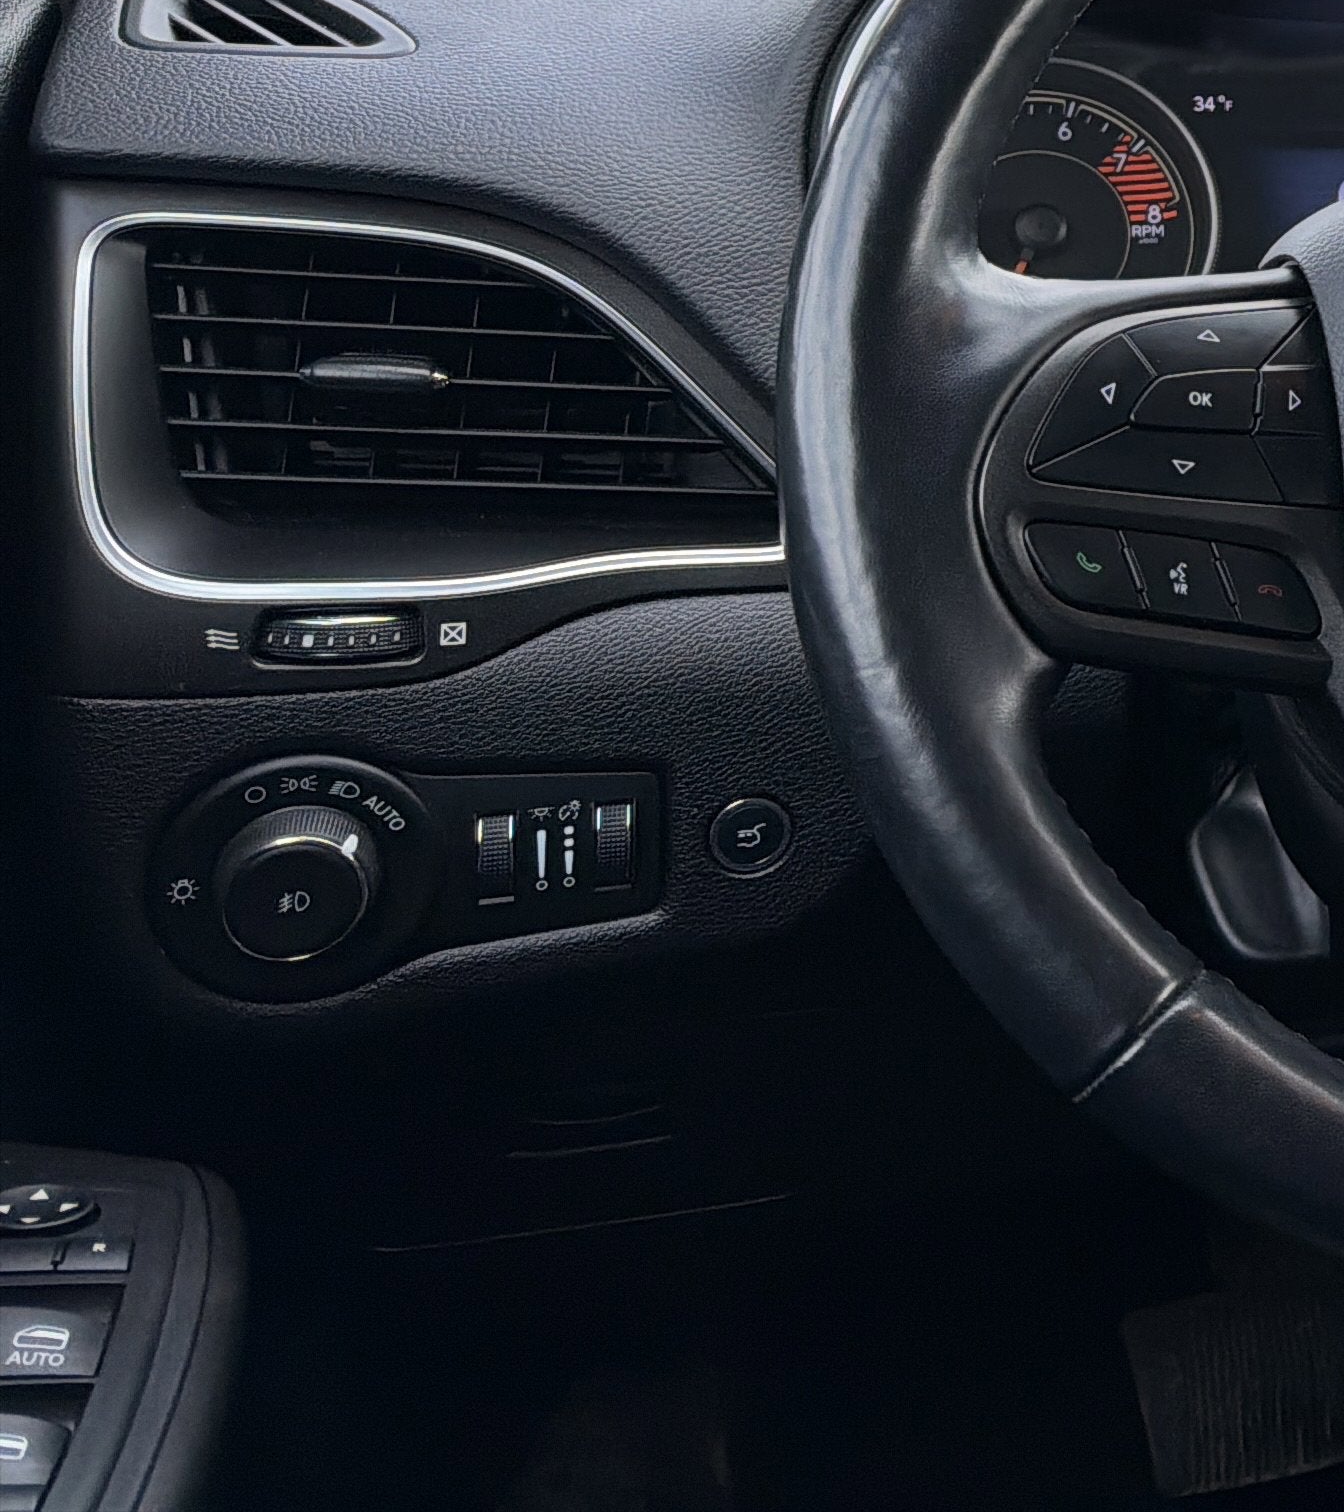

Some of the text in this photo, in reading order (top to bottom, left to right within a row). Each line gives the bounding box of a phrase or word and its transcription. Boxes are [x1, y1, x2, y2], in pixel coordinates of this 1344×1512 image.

[1192, 94, 1234, 113] 34°F
[1057, 121, 1073, 143] 6
[1112, 152, 1128, 173] 7
[1147, 204, 1162, 224] 8
[1131, 224, 1165, 238] RPM
[1188, 391, 1213, 408] OK
[1173, 582, 1189, 596] VR
[362, 795, 406, 831] AUTO
[5, 1350, 65, 1368] AUTO
